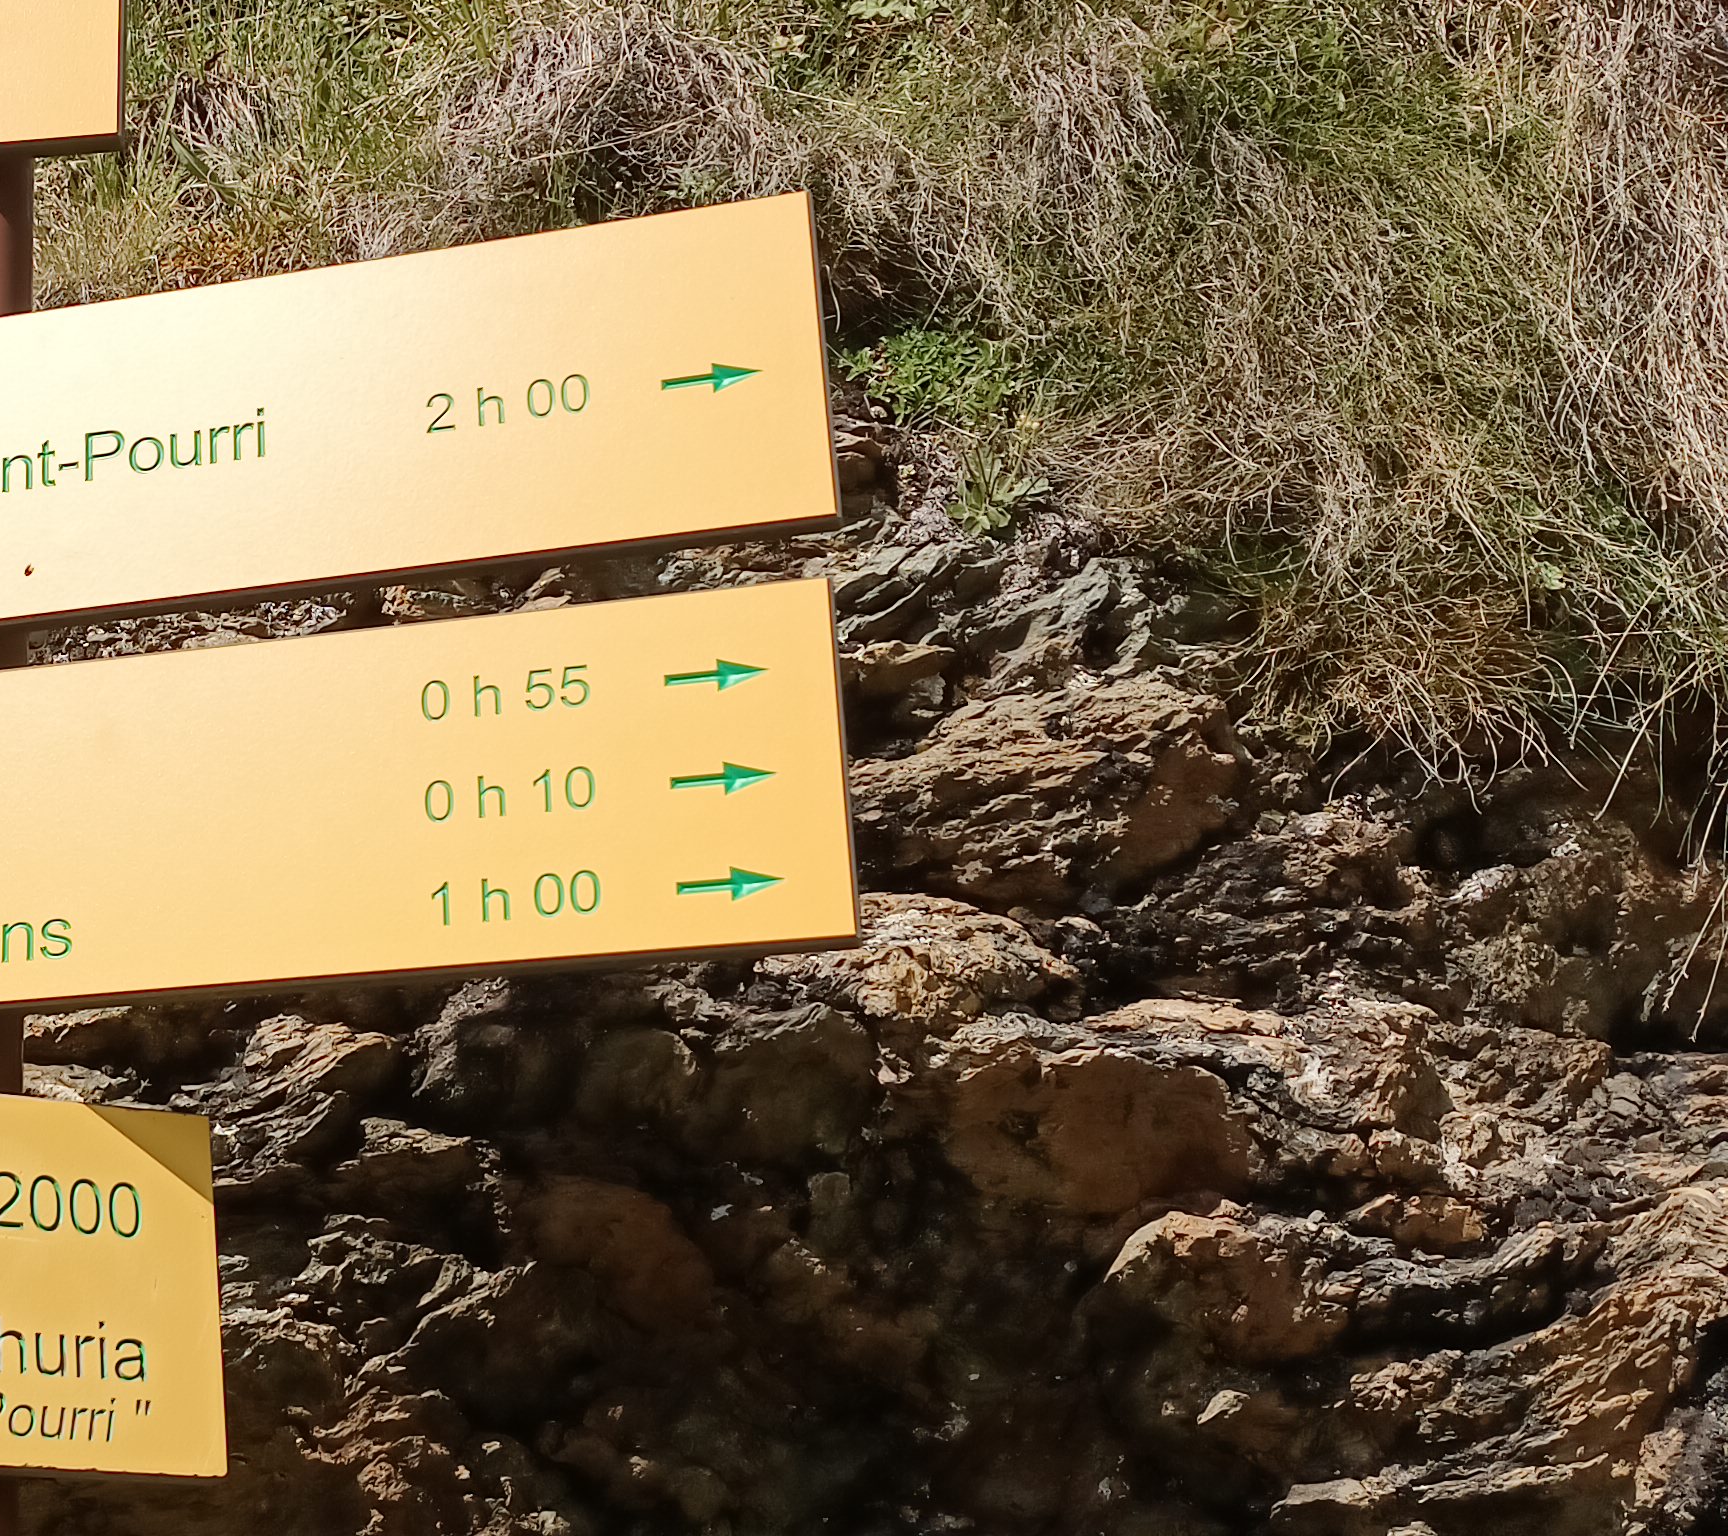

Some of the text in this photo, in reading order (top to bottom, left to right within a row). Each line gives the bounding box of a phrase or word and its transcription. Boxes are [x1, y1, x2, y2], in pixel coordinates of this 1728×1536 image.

[426, 374, 590, 433] 2 h 00
[421, 665, 590, 720] 0 h 55
[425, 766, 595, 822] 0 h 10
[431, 870, 601, 926] 1 h 00
